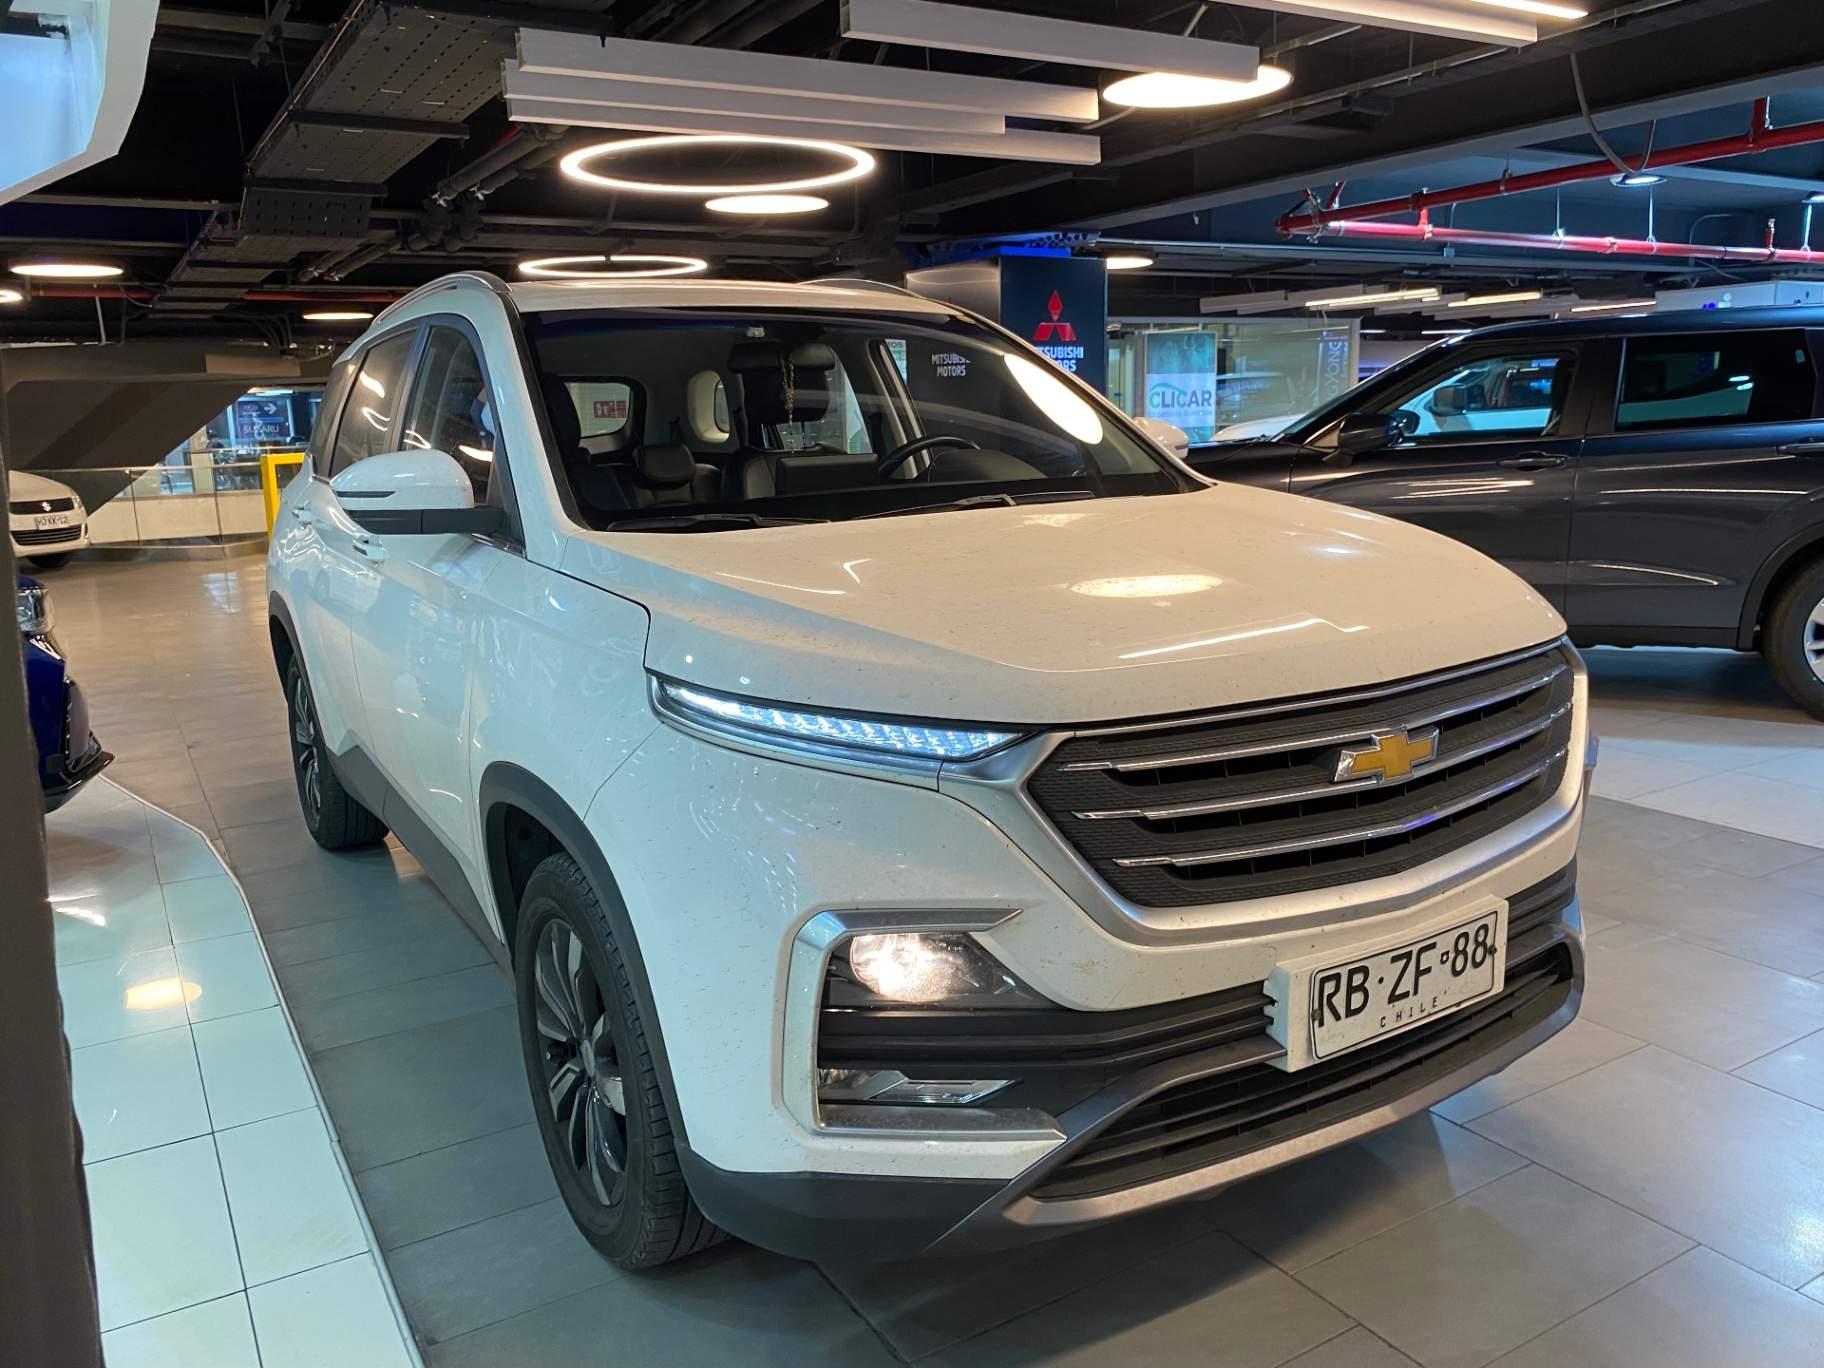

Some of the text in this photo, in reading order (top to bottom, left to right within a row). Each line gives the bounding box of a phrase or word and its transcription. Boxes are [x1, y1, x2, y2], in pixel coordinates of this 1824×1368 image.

[936, 365, 966, 377] MOTORS
[1149, 389, 1212, 409] CLICAR
[1380, 999, 1438, 1029] CHILE
